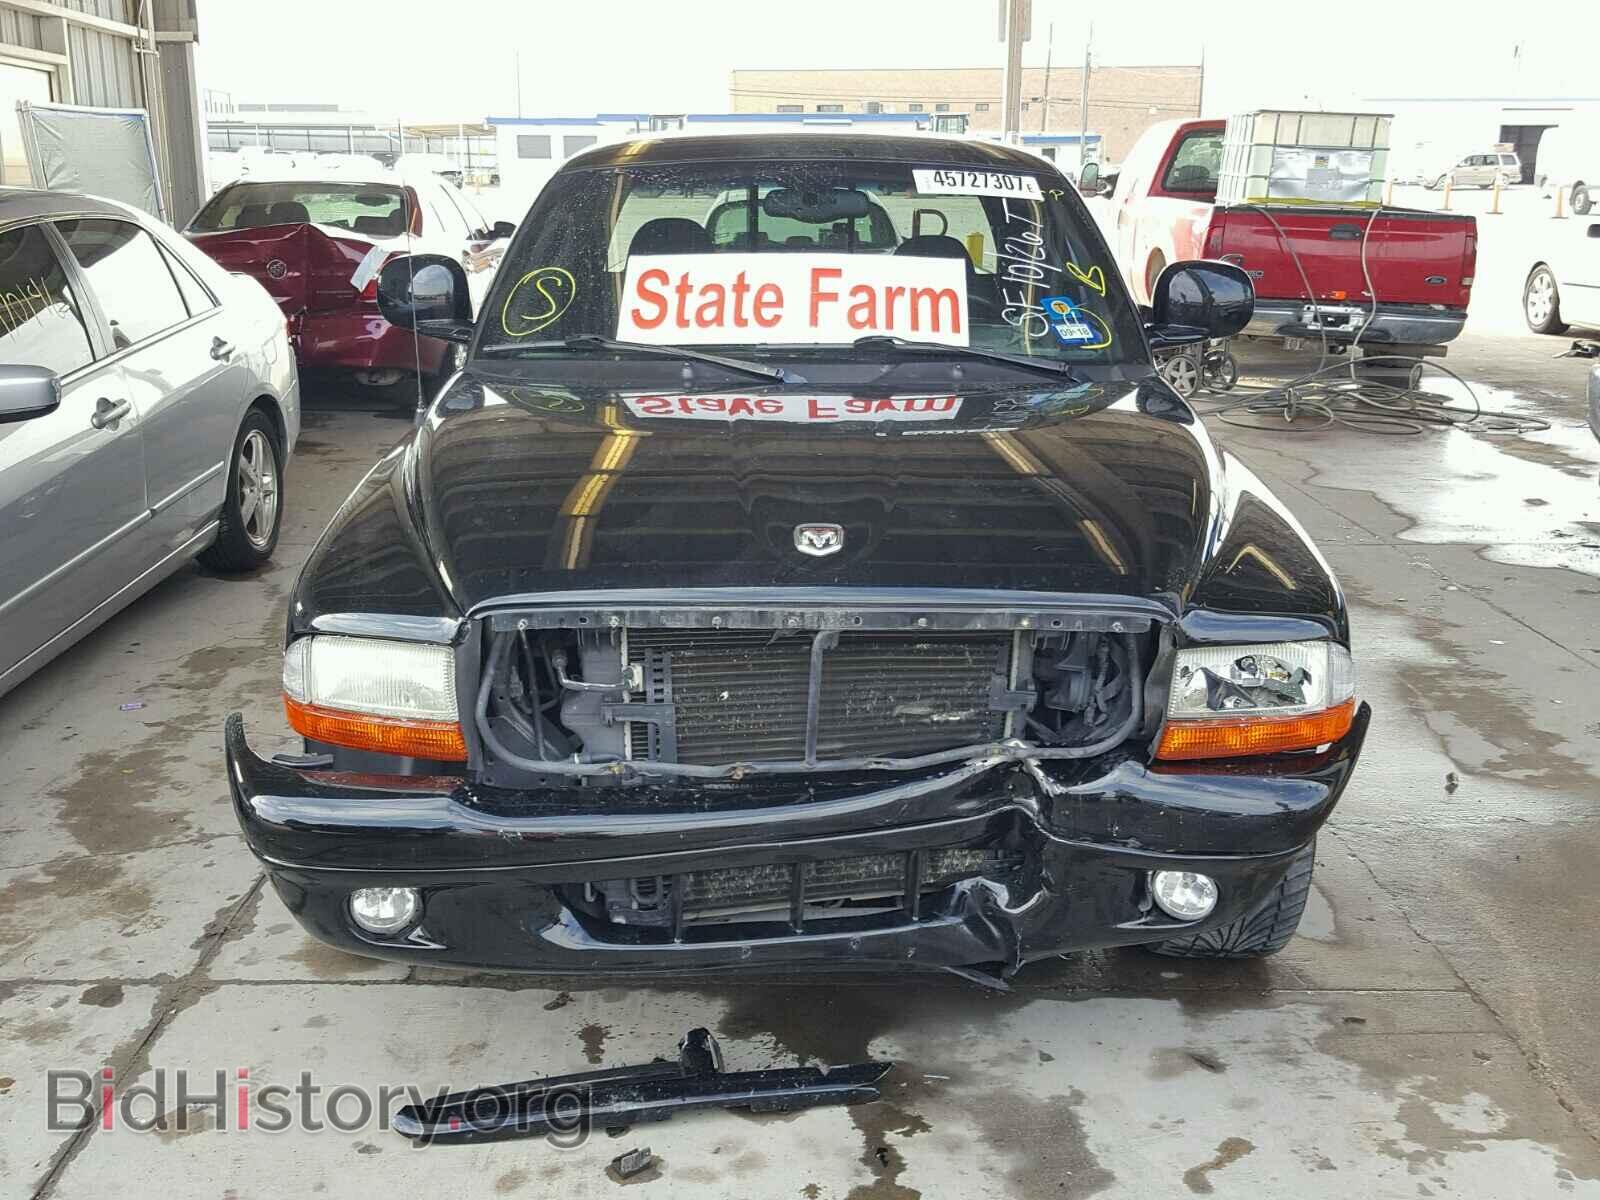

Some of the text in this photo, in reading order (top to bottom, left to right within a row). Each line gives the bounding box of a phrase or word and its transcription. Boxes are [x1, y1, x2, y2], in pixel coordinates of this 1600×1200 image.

[933, 171, 1023, 191] 45727307
[631, 267, 961, 334] State Farm
